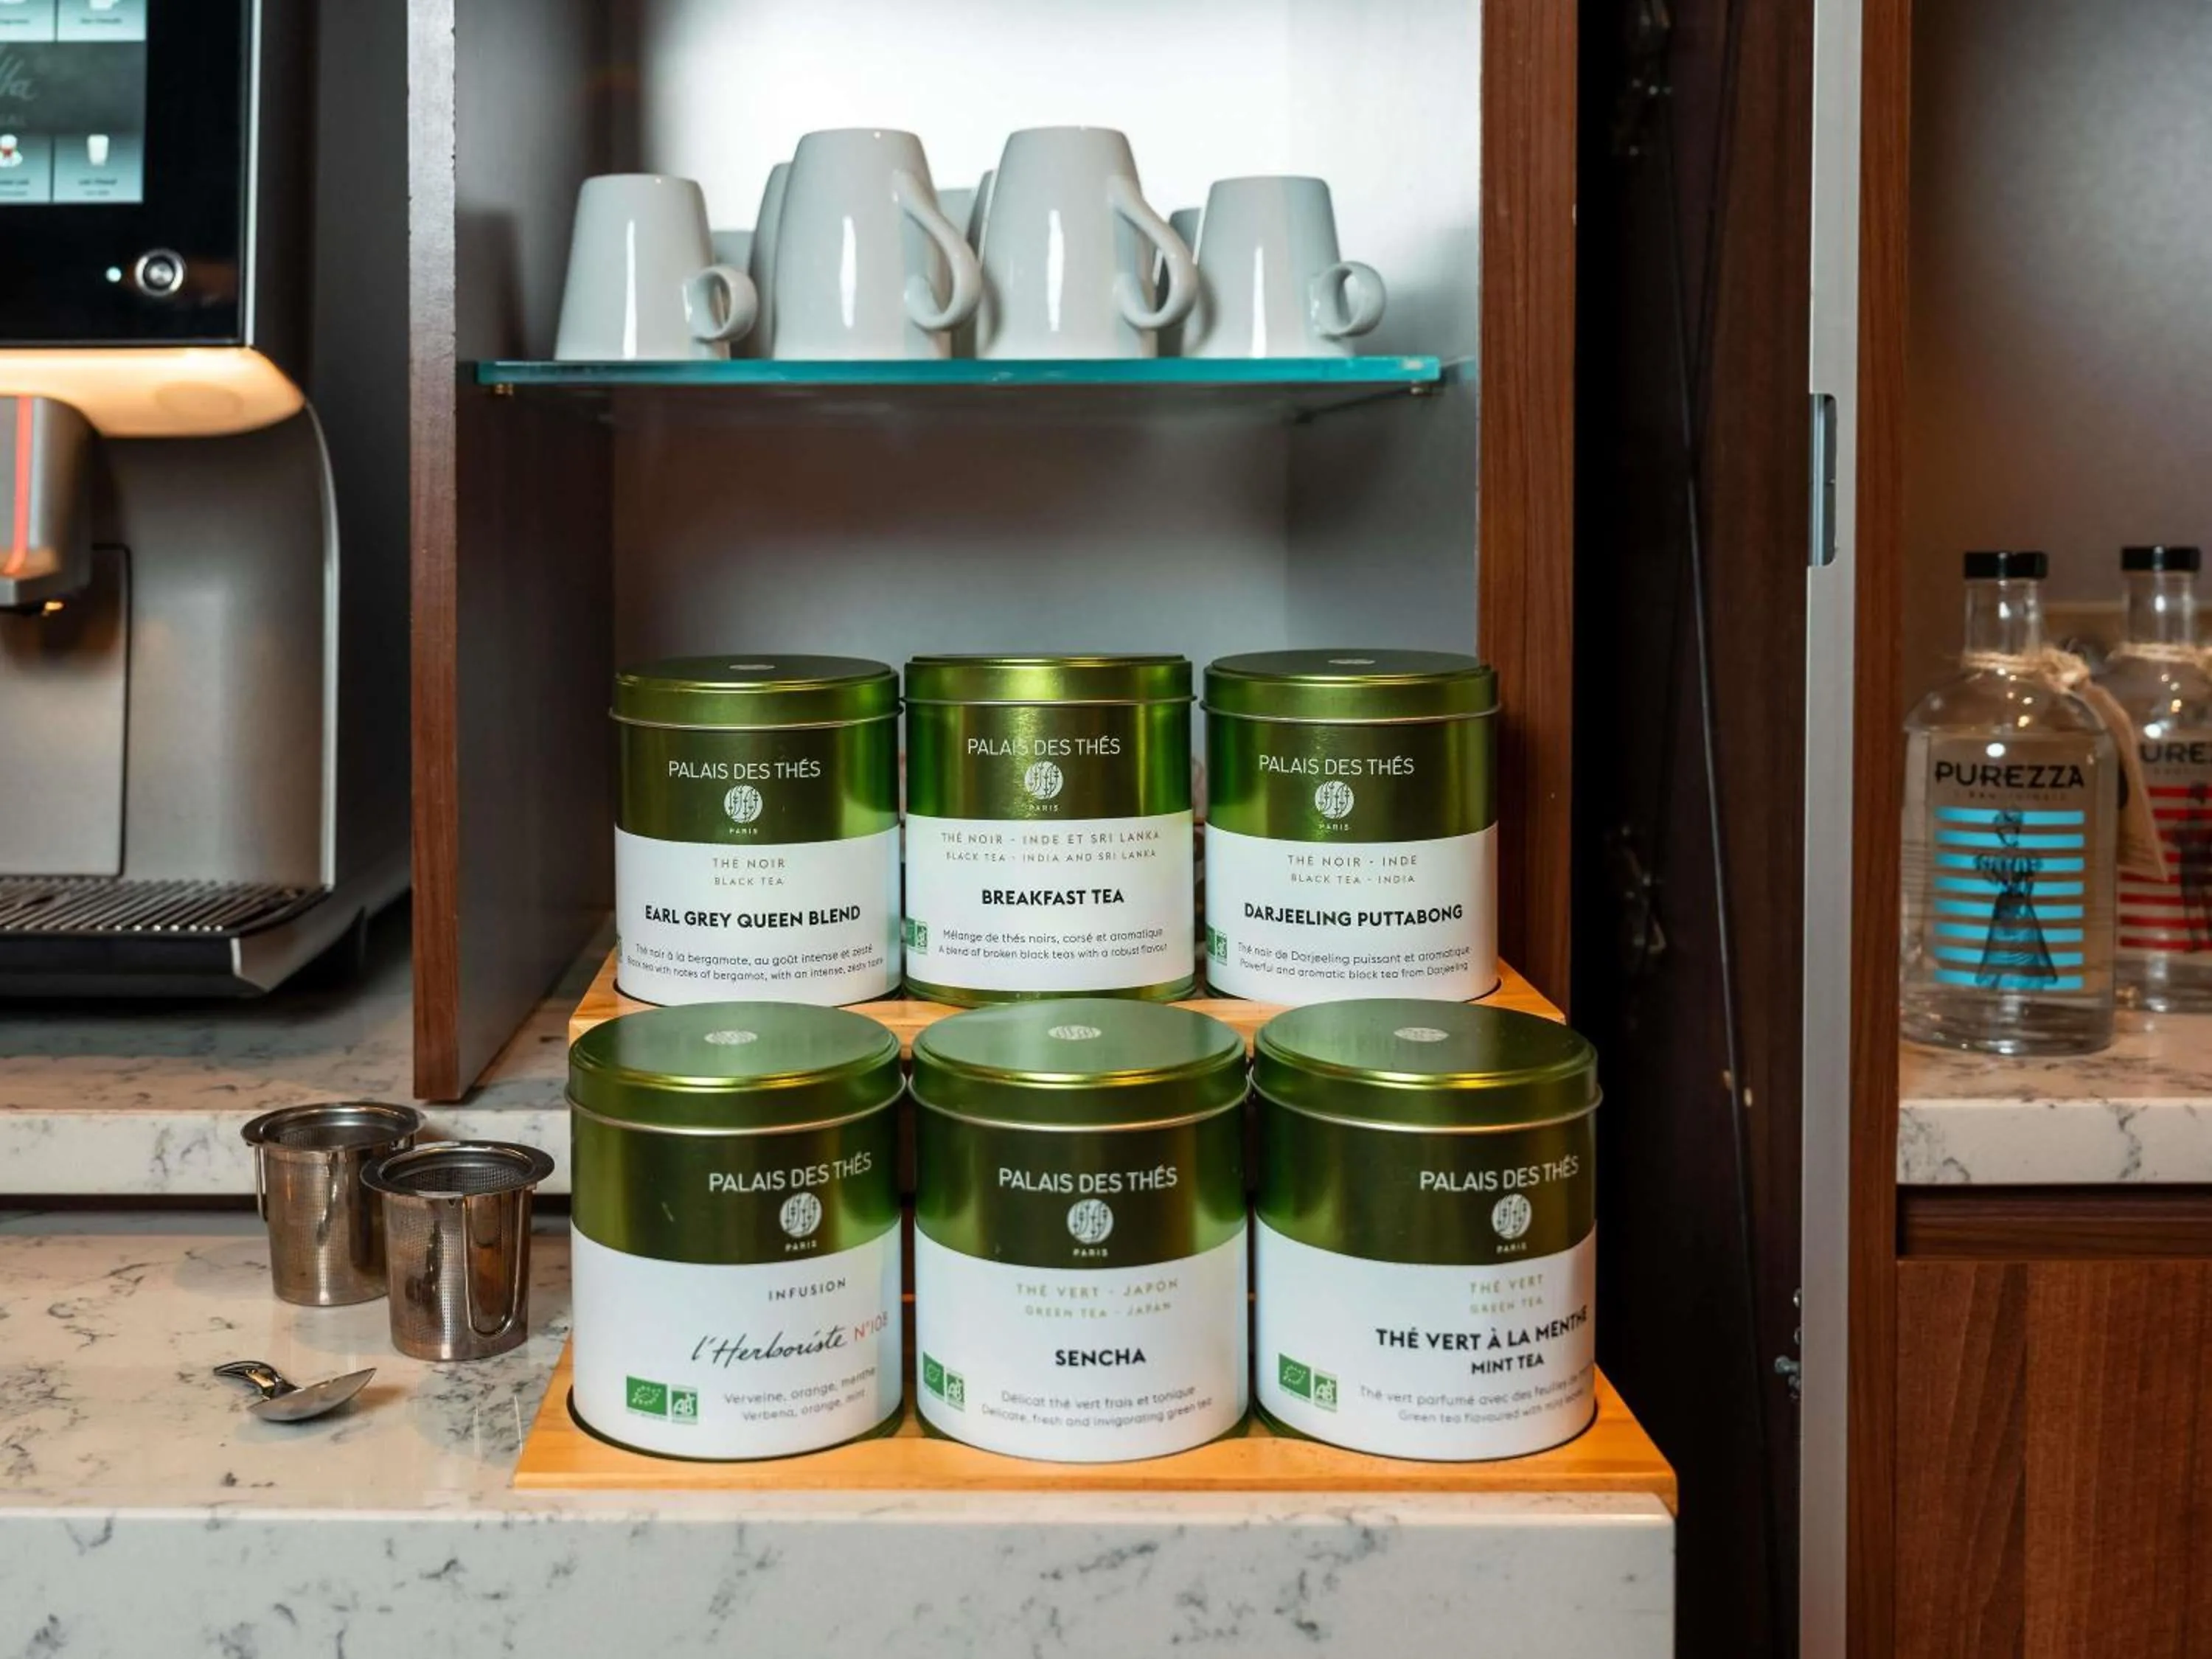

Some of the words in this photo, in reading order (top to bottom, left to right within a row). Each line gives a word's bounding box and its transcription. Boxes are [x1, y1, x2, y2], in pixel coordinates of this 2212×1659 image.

[967, 738, 1029, 757] PALAIS
[1034, 740, 1071, 757] DES
[1075, 735, 1121, 756] THÉS
[669, 761, 728, 779] PALAIS
[734, 763, 771, 779] DES
[774, 758, 821, 779] THÉS
[1259, 754, 1319, 775] PALAIS
[1325, 759, 1363, 776] DES
[1366, 755, 1415, 775] THÉS
[1934, 760, 2085, 790] PUREZZA
[968, 834, 1003, 844] NOIR
[1023, 834, 1060, 845] INDE
[1068, 834, 1084, 845] ET
[1091, 833, 1113, 844] SRI
[1120, 830, 1161, 844] LANKA
[747, 858, 785, 869] NOIR
[946, 852, 978, 860] BLACK
[984, 853, 1006, 862] TEA
[1023, 852, 1060, 863] INDIA
[1066, 852, 1093, 862] AND
[1098, 851, 1116, 861] SRI
[1121, 849, 1156, 859] LANKA
[1322, 856, 1361, 867] NOIR
[1382, 855, 1417, 866] INDE
[714, 876, 754, 886] BLACK
[761, 877, 784, 886] TEA
[1291, 873, 1330, 884] BLACK
[1337, 875, 1362, 885] TEA
[1378, 874, 1416, 884] INDIA
[981, 889, 1086, 906] BREAKFAST
[1091, 888, 1124, 904] TEA
[645, 905, 680, 924] EARL
[684, 911, 731, 928] GREY
[737, 912, 803, 928] QUEEN
[809, 905, 860, 925] BLEND
[1244, 902, 1352, 927] DARJEELING
[1357, 904, 1463, 927] PUTTABONG
[943, 929, 983, 944] Mélange
[985, 933, 999, 942] de
[1002, 933, 1026, 943] thés
[1029, 933, 1060, 945] noirs,
[1062, 932, 1093, 943] corsé
[1096, 933, 1107, 942] et
[1110, 928, 1163, 942] aromatique
[650, 949, 664, 959] noir
[676, 951, 685, 961] la
[688, 955, 751, 967] bergamote,
[772, 955, 799, 967] goût
[801, 953, 838, 964] intense
[841, 950, 849, 959] et
[939, 945, 945, 953] A
[946, 945, 969, 956] blend
[971, 947, 981, 956] of
[983, 948, 1018, 958] broken
[1020, 949, 1049, 959] black
[1052, 949, 1075, 959] teas
[1077, 948, 1099, 959] with
[1101, 950, 1108, 958] a
[1111, 945, 1139, 957] robust
[1254, 947, 1273, 958] noir
[1275, 949, 1288, 959] de
[1291, 950, 1351, 966] Darjeeling
[1353, 954, 1401, 966] puissant
[1404, 953, 1415, 962] et
[642, 962, 654, 972] tea
[655, 964, 672, 975] with
[673, 967, 698, 978] notes
[700, 970, 711, 978] of
[713, 970, 768, 983] bergamot,
[771, 970, 792, 981] with
[794, 971, 807, 979] an
[810, 967, 846, 978] intense,
[1276, 967, 1295, 975] and
[1298, 969, 1345, 979] aromatic
[1349, 970, 1378, 979] black
[1381, 970, 1399, 978] tea
[1401, 968, 1424, 978] from
[709, 1170, 786, 1192] PALAIS
[790, 1164, 830, 1189] DES
[832, 1150, 872, 1180] THÉS
[999, 1167, 1074, 1193] PALAIS
[1079, 1173, 1123, 1194] DES
[1126, 1164, 1178, 1192] THÉS
[1419, 1169, 1498, 1192] PALAIS
[1503, 1166, 1540, 1190] DES
[1543, 1154, 1579, 1181] THÉS
[785, 1239, 818, 1252] PARIS
[1073, 1248, 1109, 1257] PARIS
[1496, 1242, 1527, 1254] PARIS
[768, 1277, 846, 1301] INFUSION
[1057, 1286, 1098, 1299] VERT
[1123, 1278, 1179, 1297] JAPON
[1509, 1274, 1543, 1290] VERT
[1025, 1304, 1073, 1318] GREEN
[1081, 1307, 1107, 1319] TEA
[1126, 1302, 1171, 1317] JAPAN
[1470, 1302, 1514, 1315] GREEN
[1521, 1296, 1544, 1308] TEA
[1376, 1327, 1419, 1349] THÉ
[1426, 1332, 1482, 1351] VERT
[1486, 1326, 1501, 1349] À
[1507, 1327, 1531, 1347] LA
[1054, 1349, 1147, 1367] SENCHA
[1471, 1357, 1514, 1376] MINT
[1517, 1352, 1545, 1369] TEA
[723, 1392, 787, 1405] Verveine,
[1075, 1399, 1101, 1411] vert
[1105, 1397, 1133, 1409] frais
[1136, 1395, 1150, 1406] et
[1386, 1391, 1412, 1404] vert
[1478, 1394, 1511, 1406] avec
[742, 1408, 799, 1422] Verbena,
[1065, 1416, 1090, 1427] and
[1093, 1411, 1165, 1427] invigorating
[1398, 1408, 1437, 1423] Green
[1440, 1412, 1461, 1425] tea
